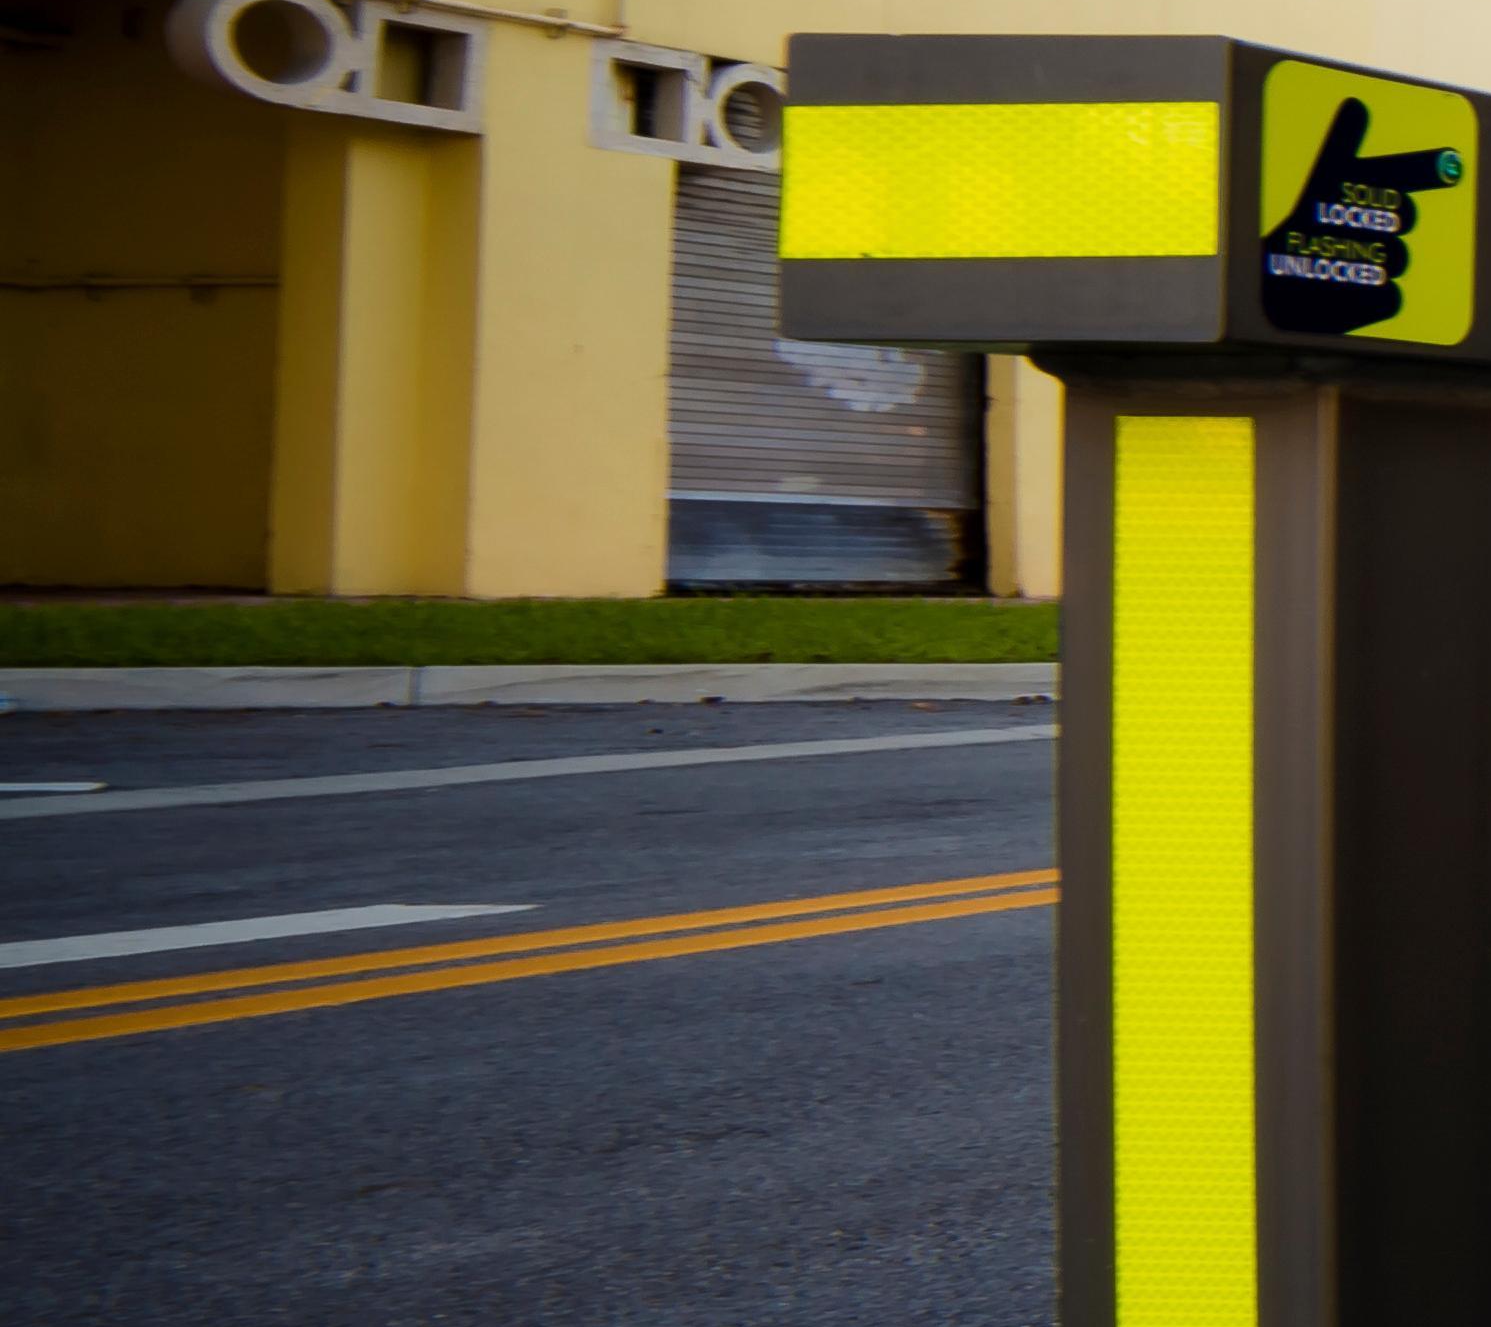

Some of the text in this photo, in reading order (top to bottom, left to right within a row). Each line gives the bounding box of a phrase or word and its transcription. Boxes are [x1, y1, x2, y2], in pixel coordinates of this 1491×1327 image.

[1341, 181, 1402, 209] SOLID
[1318, 203, 1401, 232] LOCKED
[1288, 232, 1387, 263] FLASHING
[1270, 254, 1388, 285] UNLOCKED
